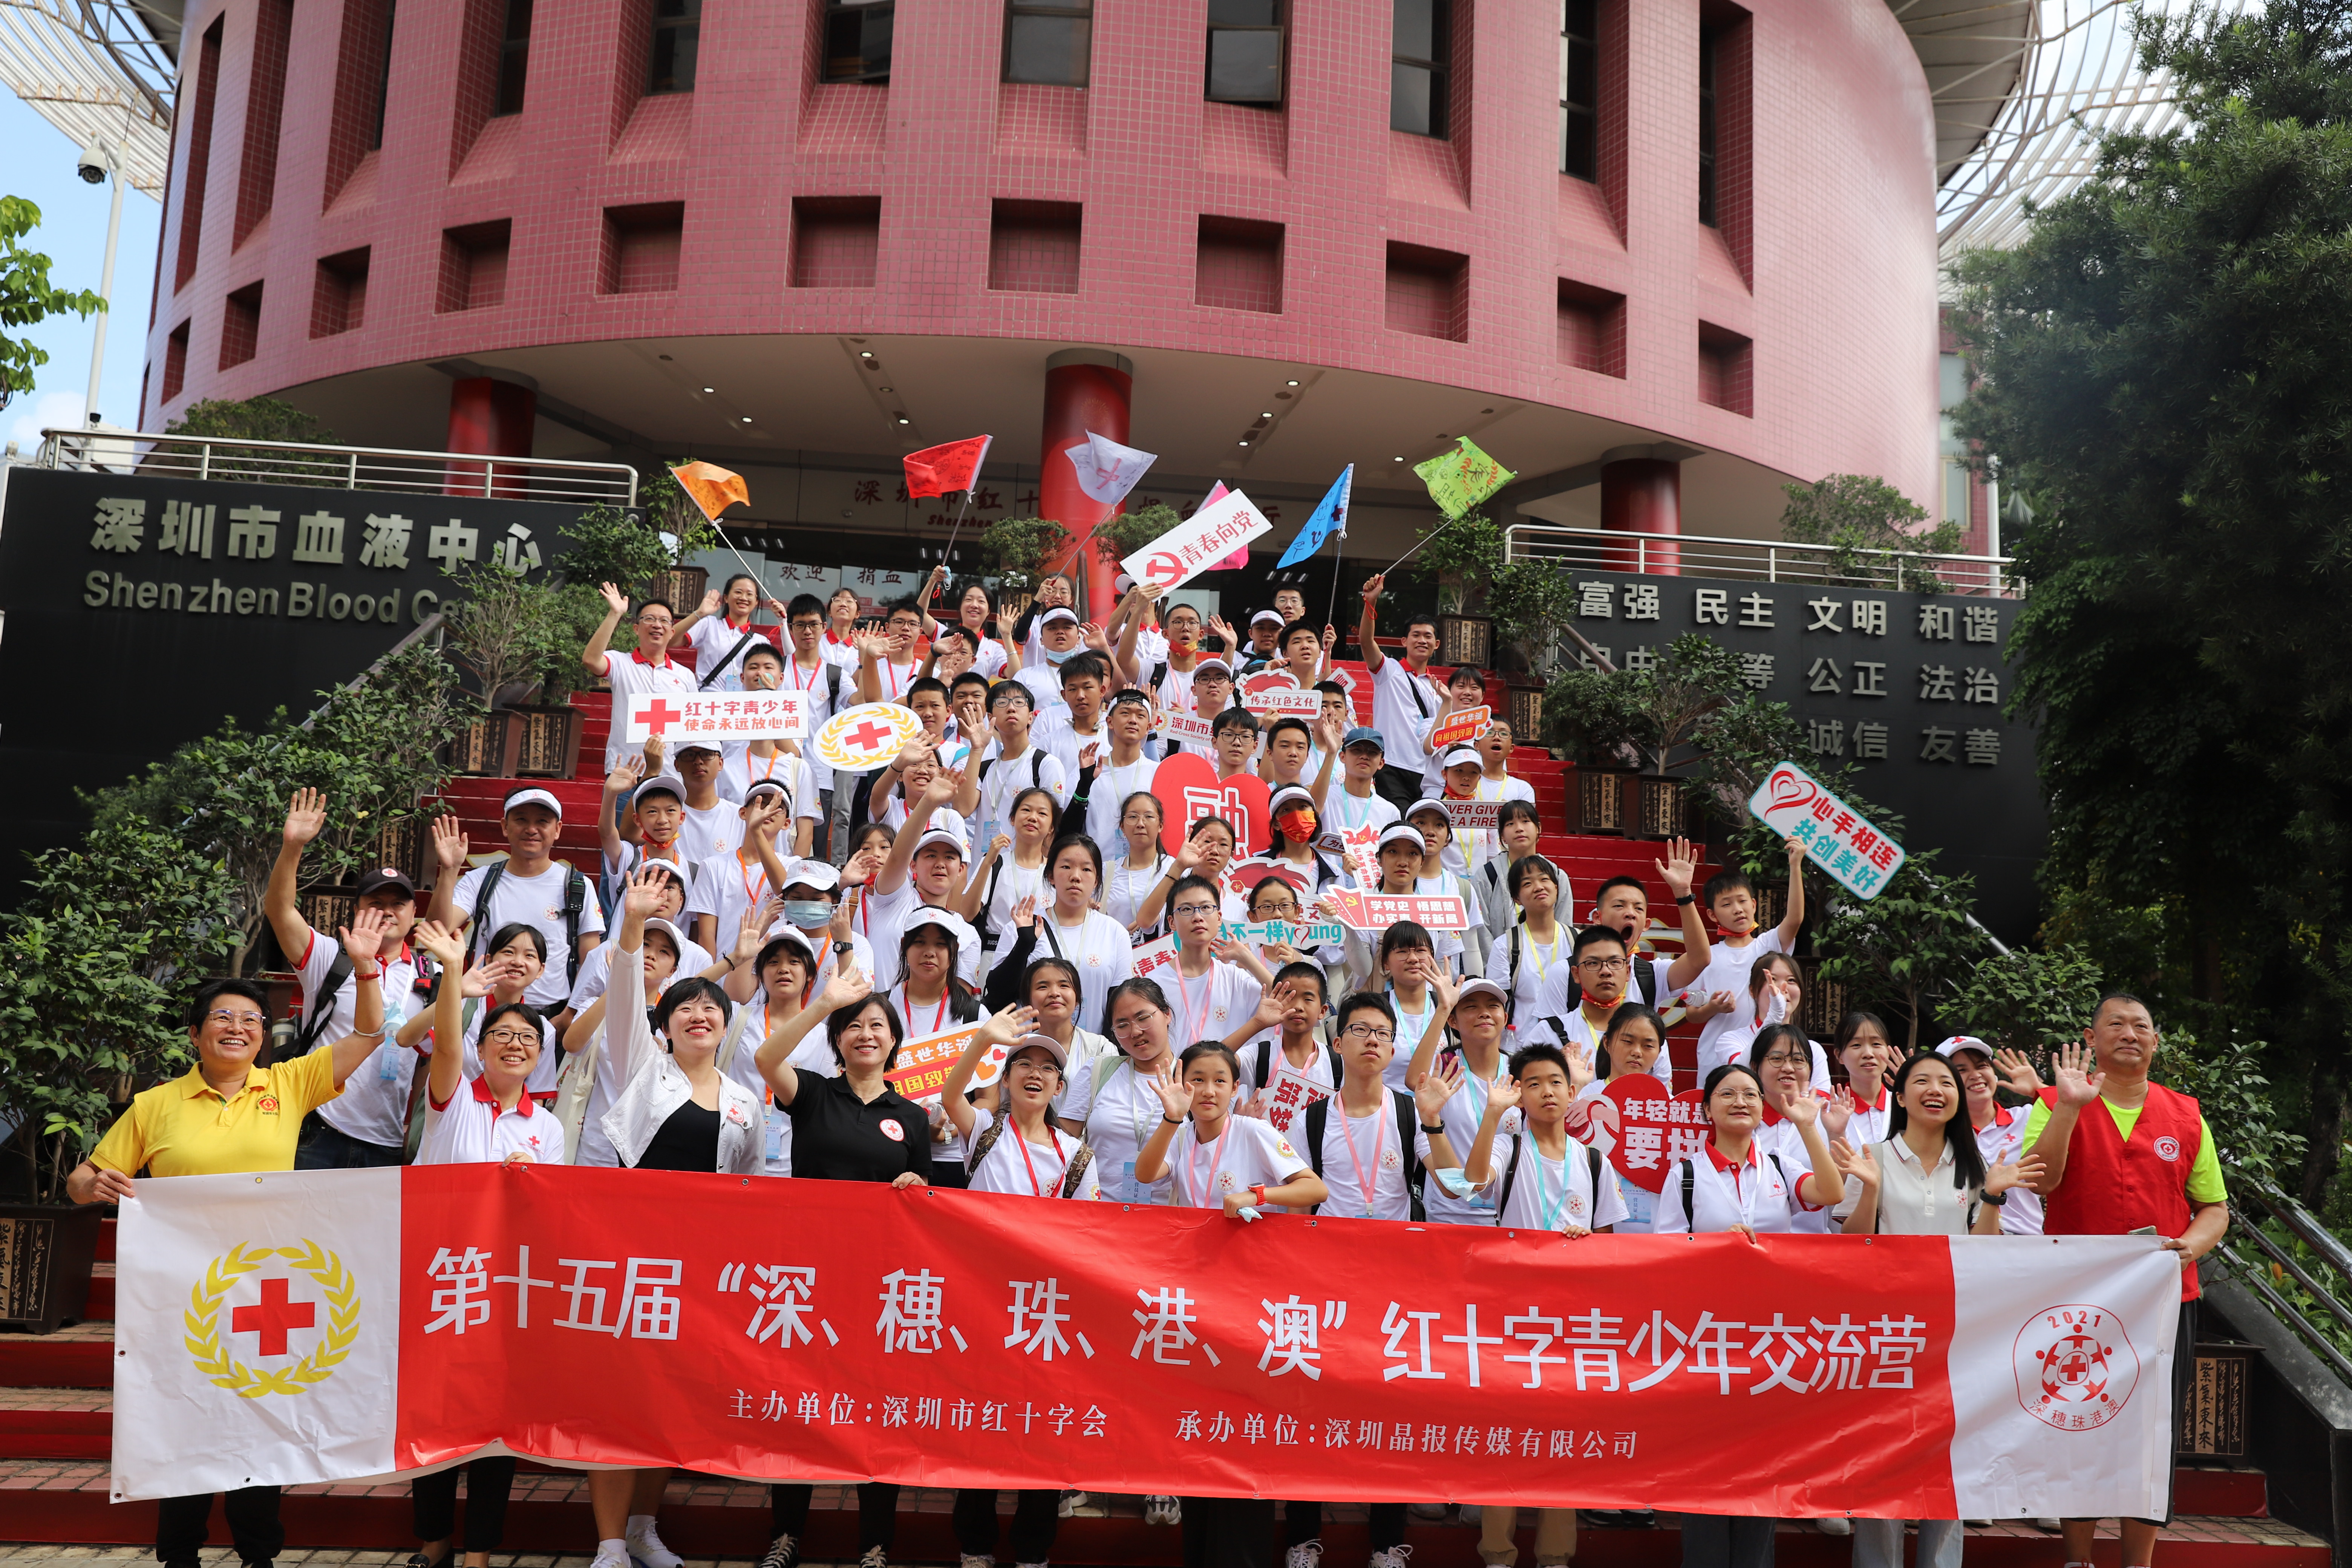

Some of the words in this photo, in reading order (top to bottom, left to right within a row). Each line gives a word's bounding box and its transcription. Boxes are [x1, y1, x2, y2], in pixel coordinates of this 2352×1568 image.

[90, 498, 542, 577] 深圳市血液中心
[1178, 510, 1258, 566] 青春向党
[779, 564, 826, 582] 欢迎
[857, 568, 902, 585] 捐血
[84, 570, 279, 615] Shenzhen
[288, 582, 401, 623] Blood
[1578, 581, 1660, 620] 富强
[1696, 588, 1775, 628] 民主
[1807, 596, 1886, 635] 文明
[1919, 604, 1998, 643] 和谐
[1807, 657, 1887, 696] 公正
[1920, 664, 1999, 704] 法治
[684, 699, 798, 716] 红十字青少年
[1250, 695, 1315, 707] 传承红色文化
[684, 717, 799, 732] 使命永远放心间
[1450, 710, 1483, 726] 盛世华诞
[1435, 727, 1473, 743] 向祖国致敬
[1807, 719, 1888, 758] 诚信
[1920, 725, 2000, 765] 友善
[1458, 816, 1466, 826] A
[1469, 817, 1497, 827] FIRE
[1811, 796, 1897, 871] 心手相连
[1353, 847, 1373, 889] 弘扬革命精神
[1791, 818, 1881, 893] 共创美好
[1370, 900, 1410, 911] 学党史
[1417, 901, 1456, 912] 悟思想
[1373, 913, 1412, 924] 办实事
[1419, 914, 1458, 924] 开新局
[1137, 949, 1177, 978] 青春
[1269, 1078, 1303, 1132] 筑梦
[424, 1244, 683, 1341] 第十五届
[1380, 1300, 1926, 1395] 红十字青少年交流营
[2047, 1310, 2101, 1329] 2021
[2029, 1398, 2120, 1429] 深穗珠港澳
